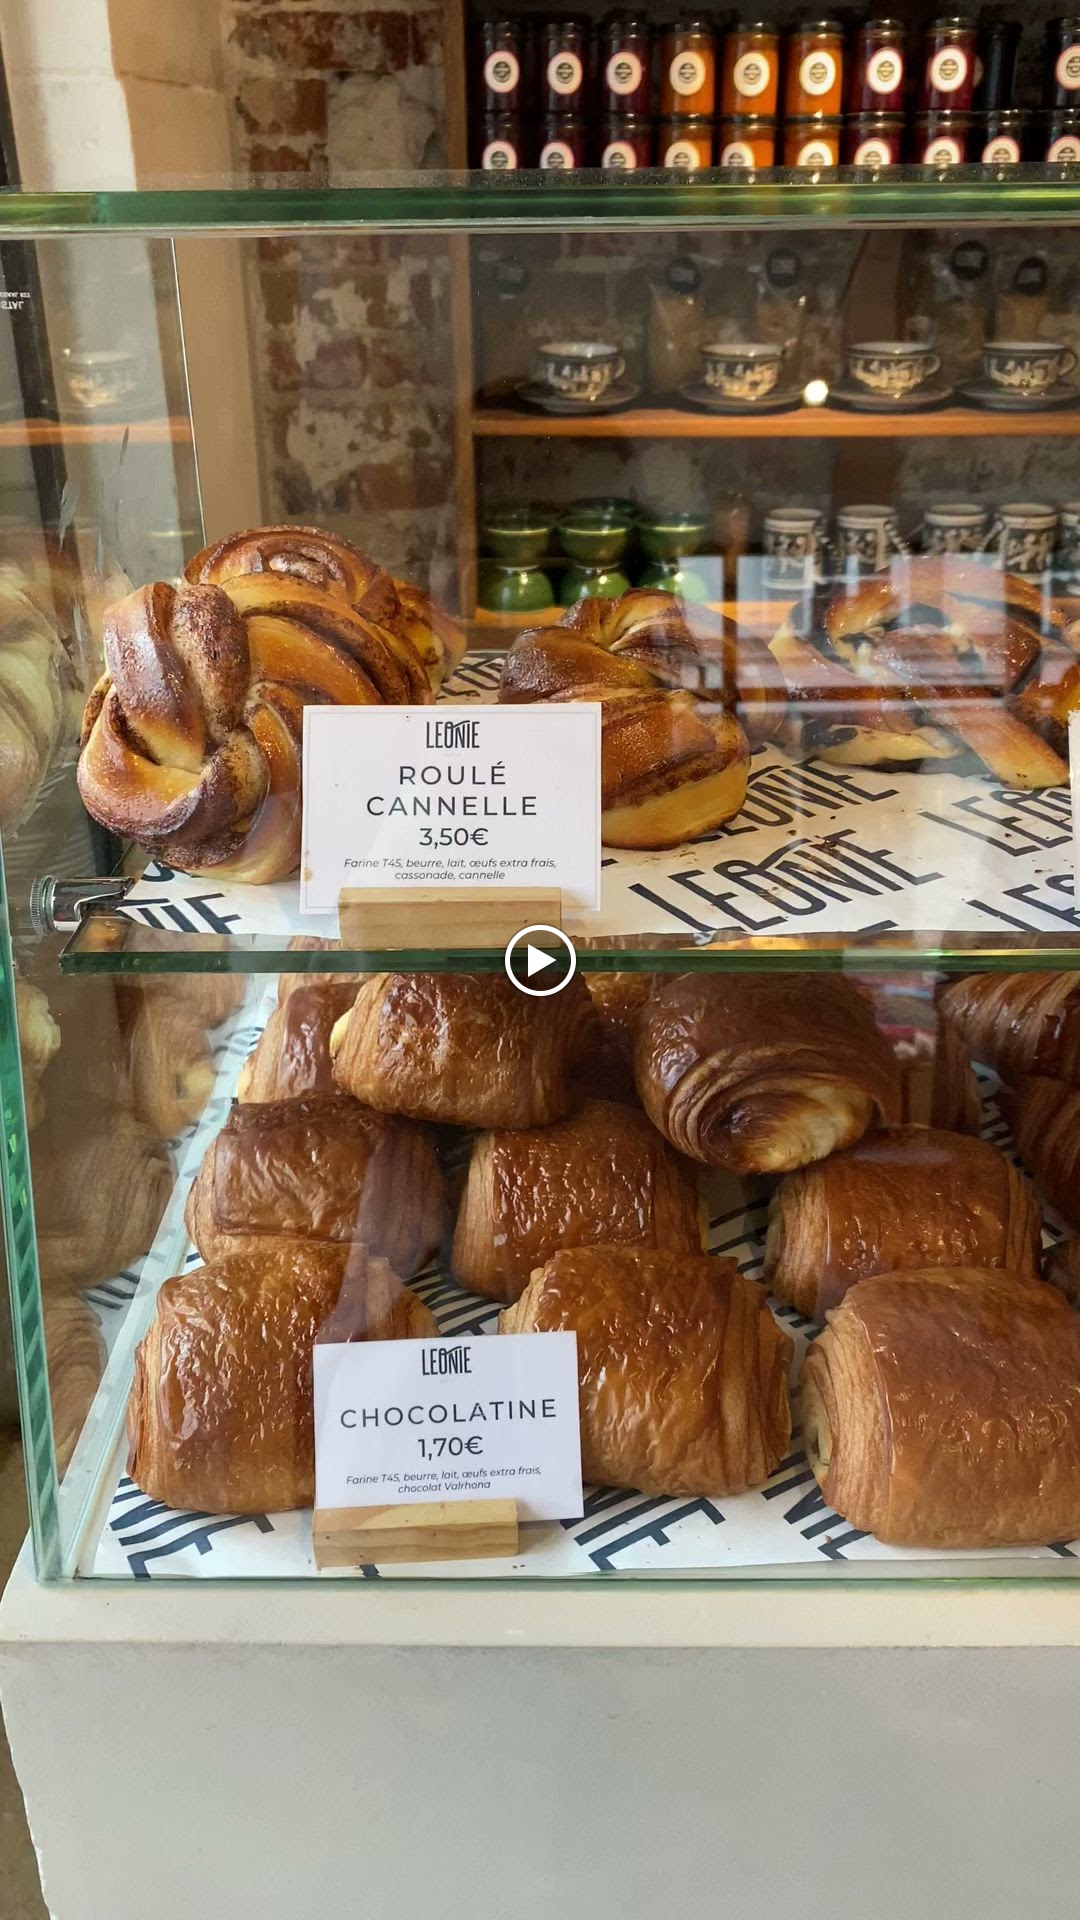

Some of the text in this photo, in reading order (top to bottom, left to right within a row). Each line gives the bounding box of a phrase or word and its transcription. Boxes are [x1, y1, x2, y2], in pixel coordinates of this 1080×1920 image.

[426, 720, 480, 748] LEONIE
[399, 761, 506, 785] ROULÉ
[366, 796, 538, 816] CANNELLE
[419, 827, 489, 849] 3,50€
[344, 858, 557, 869] Farine T45, beurre, lait, œufs extra frais,
[394, 870, 506, 881] cassonade, cannelle
[628, 829, 946, 932] LEONIE
[421, 1346, 472, 1376] LEONIE
[340, 1398, 557, 1429] CHOCOLATINE
[417, 1435, 484, 1461] 1,70€
[346, 1466, 542, 1485] Farine T45, beurre, lait, œufs extra frais,
[398, 1481, 491, 1493] chocolat Valrhona
